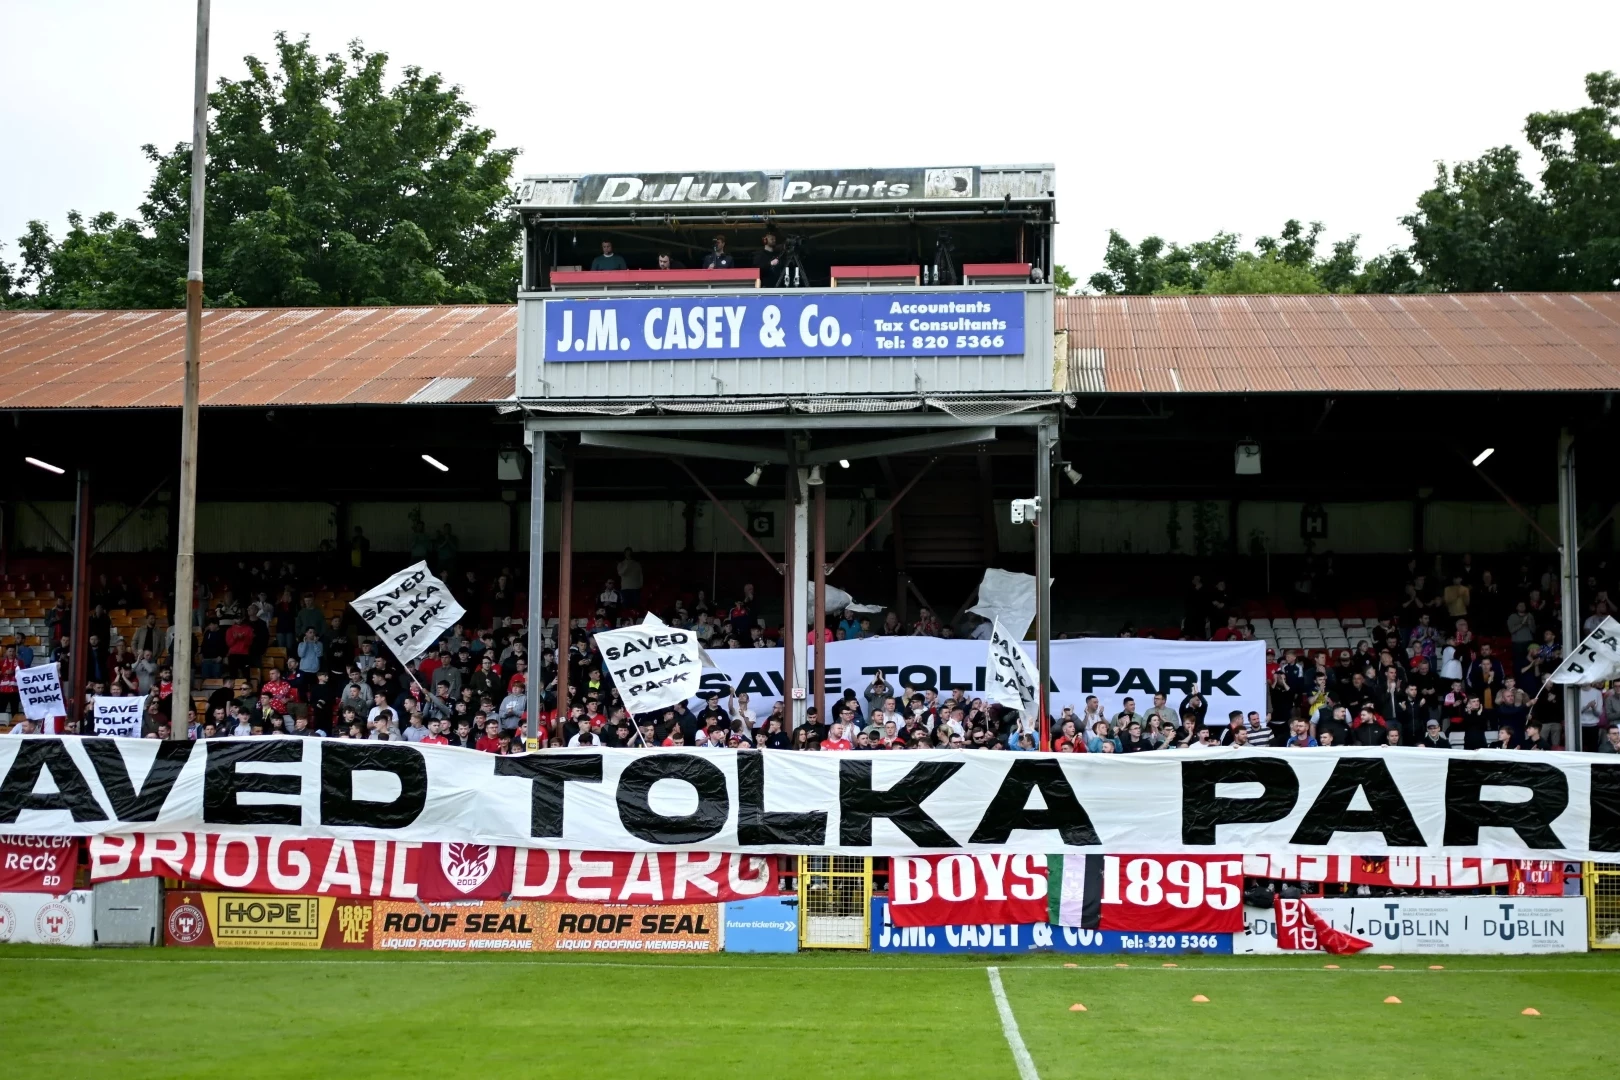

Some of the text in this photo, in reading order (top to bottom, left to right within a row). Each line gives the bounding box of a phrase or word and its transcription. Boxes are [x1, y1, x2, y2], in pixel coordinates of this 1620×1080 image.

[597, 176, 910, 202] Dulux Paints
[890, 301, 991, 314] Accountants
[557, 304, 852, 352] J.M. CASEY & Co.
[874, 318, 1007, 332] Tax Consultants
[876, 334, 1005, 350] Tel: 820 5366
[753, 516, 770, 533] G
[1306, 516, 1323, 533] H
[362, 570, 426, 621] SAVED
[375, 585, 440, 634] TOLKA
[394, 599, 447, 647] PARK
[606, 632, 688, 661] SAVED
[613, 653, 693, 683] TOLKA
[21, 672, 54, 685] SAVE
[628, 671, 691, 696] PARK
[1081, 666, 1243, 697] PARK
[20, 683, 60, 696] TOLKA
[28, 693, 62, 706] PARK
[98, 704, 138, 714] SAVE
[494, 748, 1102, 848] TOLKA
[1182, 756, 1620, 853] PAR
[43, 875, 61, 886] BD
[890, 853, 1243, 911] BOYS 1895
[225, 902, 302, 923] HOPE
[337, 905, 372, 921] 1895
[339, 918, 369, 932] PALE
[383, 913, 532, 933] ROOF SEAL
[558, 914, 710, 934] ROOF SEAL
[726, 920, 785, 930] future ticketing
[343, 928, 365, 943] ALE
[381, 938, 533, 949] LIQUID ROOFING MEMBRANE
[1032, 922, 1054, 947] &
[1121, 935, 1144, 949] Tel:
[1148, 935, 1176, 949] 820
[1180, 935, 1218, 949] 5366
[556, 939, 710, 950] LIQUID ROOFING MEMBRANE
